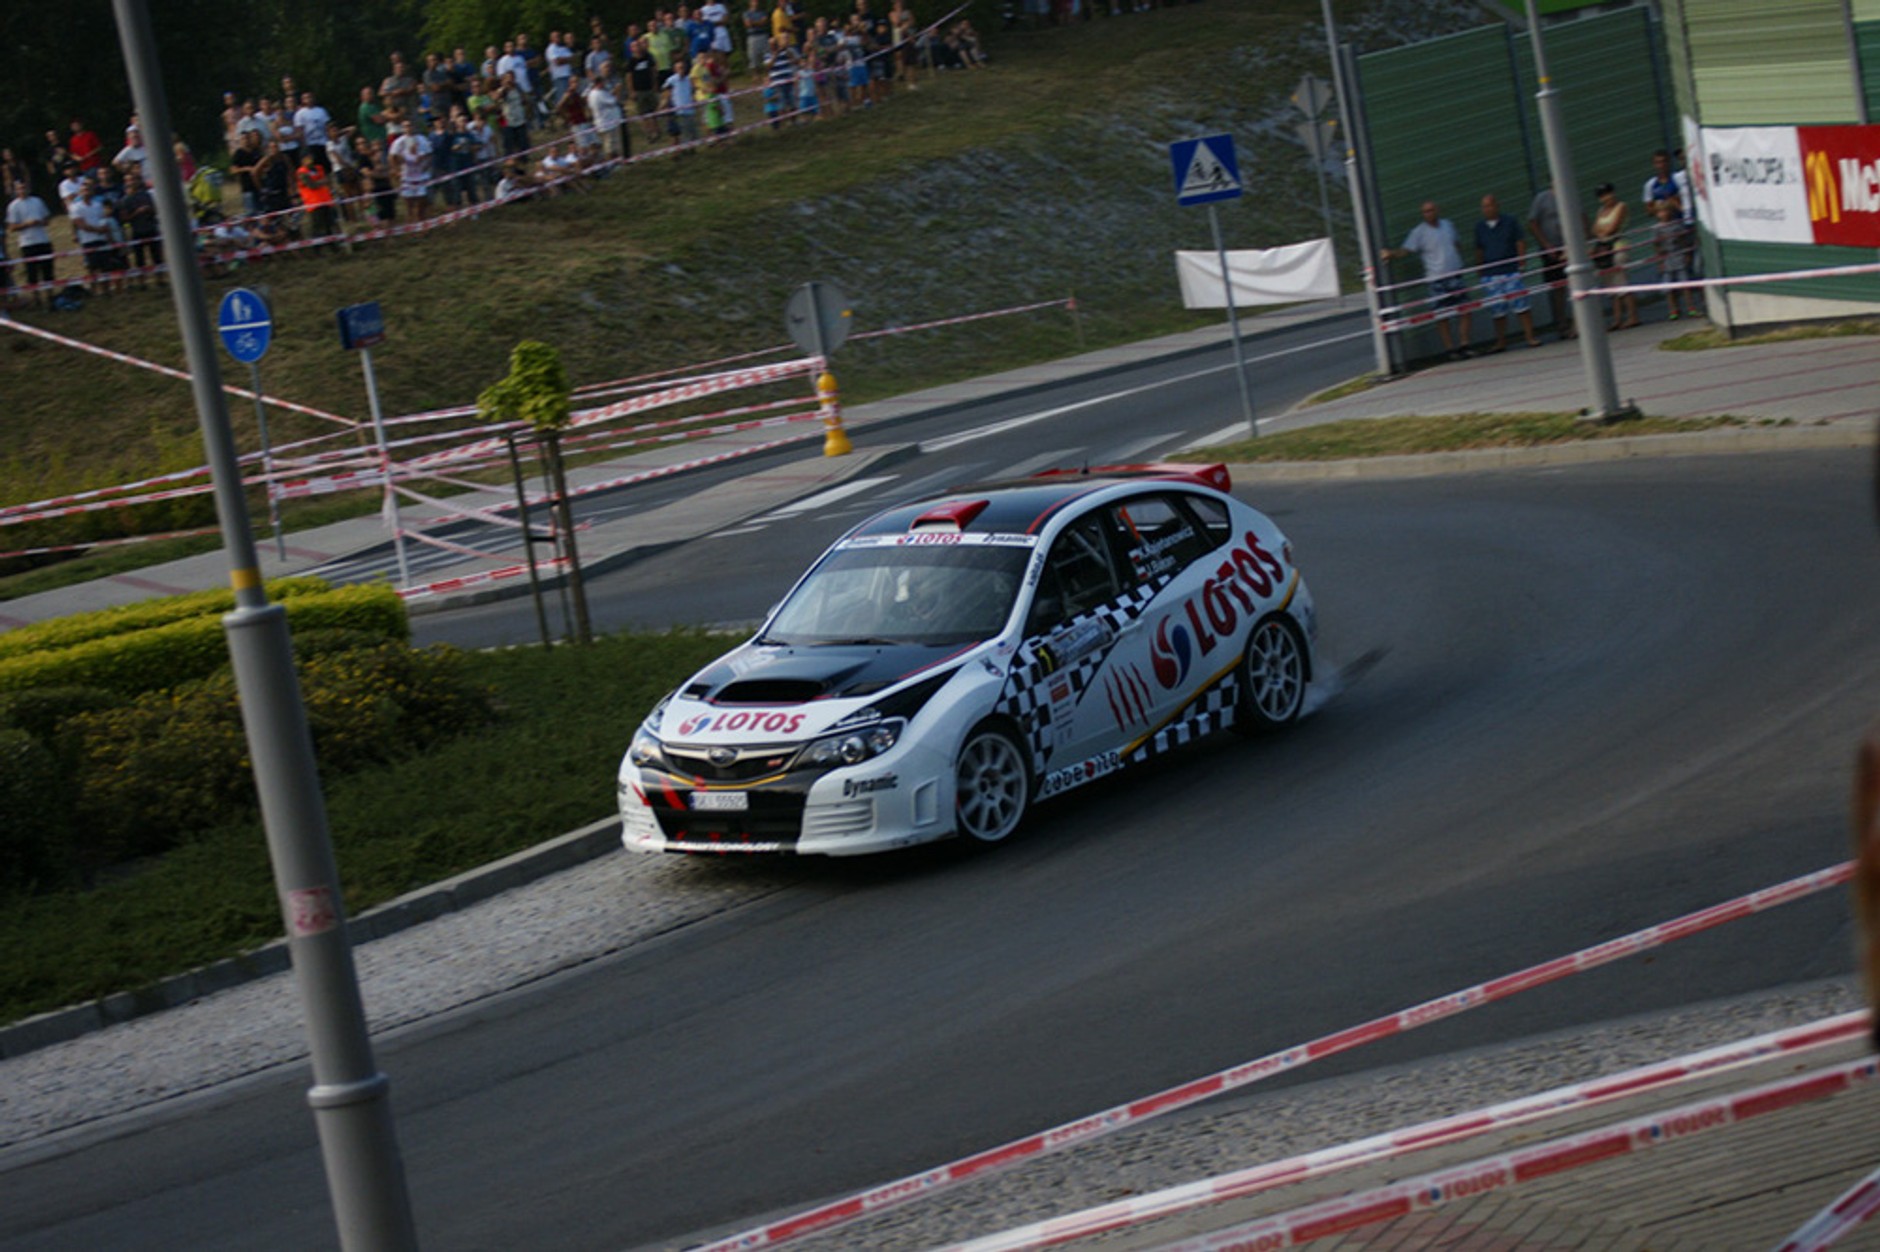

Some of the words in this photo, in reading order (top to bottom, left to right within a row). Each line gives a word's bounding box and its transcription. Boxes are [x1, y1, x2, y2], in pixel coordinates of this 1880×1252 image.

[915, 533, 963, 545] LOTOS
[1184, 530, 1284, 657] LOTOS
[710, 711, 806, 734] LOTOS
[843, 771, 899, 797] Dynamic
